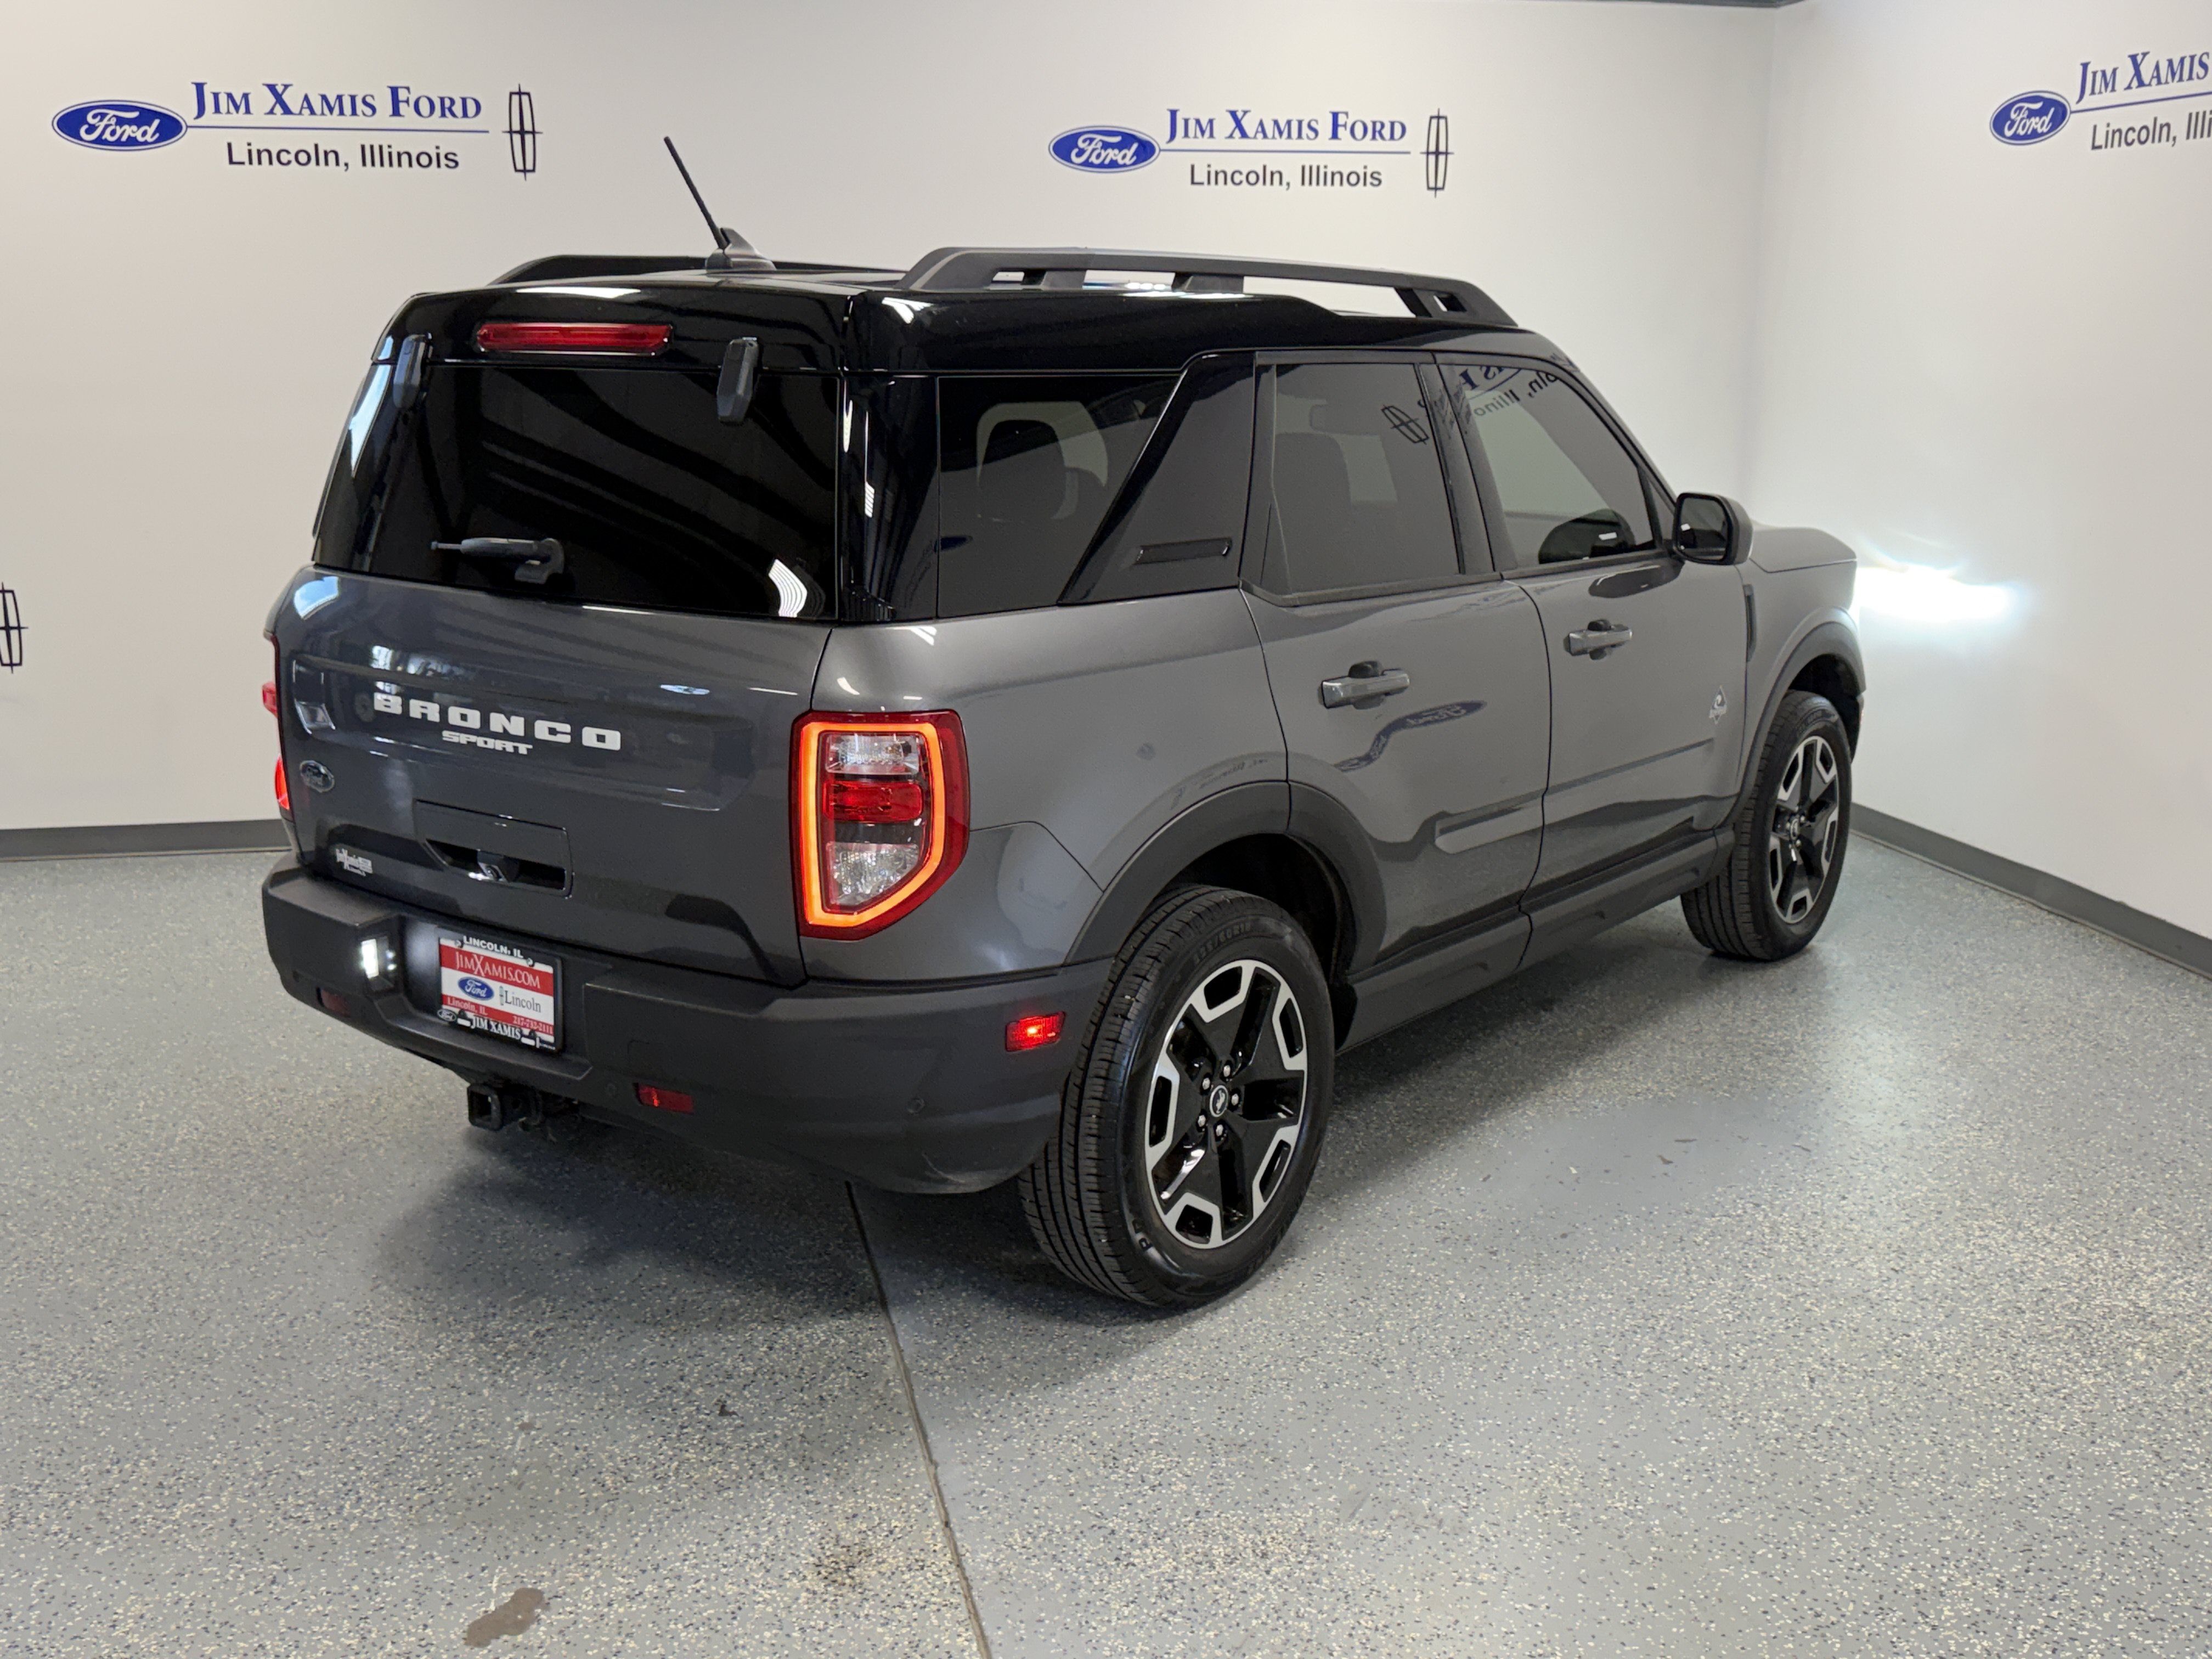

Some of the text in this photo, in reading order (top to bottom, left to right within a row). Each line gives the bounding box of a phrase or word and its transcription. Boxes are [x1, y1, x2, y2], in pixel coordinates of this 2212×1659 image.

[2076, 52, 2210, 105] JIM XAMIS
[191, 82, 482, 120] JIM XAMIS FORD
[79, 108, 159, 144] Ford
[1166, 109, 1407, 144] JIM XAMIS FORD
[2004, 101, 2055, 137] Ford
[2091, 116, 2177, 151] Lincoln,
[227, 142, 460, 172] Lincoln, Illinois
[1070, 133, 1137, 165] Ford
[1190, 165, 1383, 190] Lincoln, Illinois
[374, 692, 621, 751] BRONCO
[442, 730, 533, 755] SPORT
[513, 947, 524, 959] IL
[455, 951, 541, 989] JIMXAMIS.COM
[465, 979, 487, 997] Ford
[505, 990, 541, 1013] Lincoln
[470, 1017, 521, 1040] JIM XAMIS
